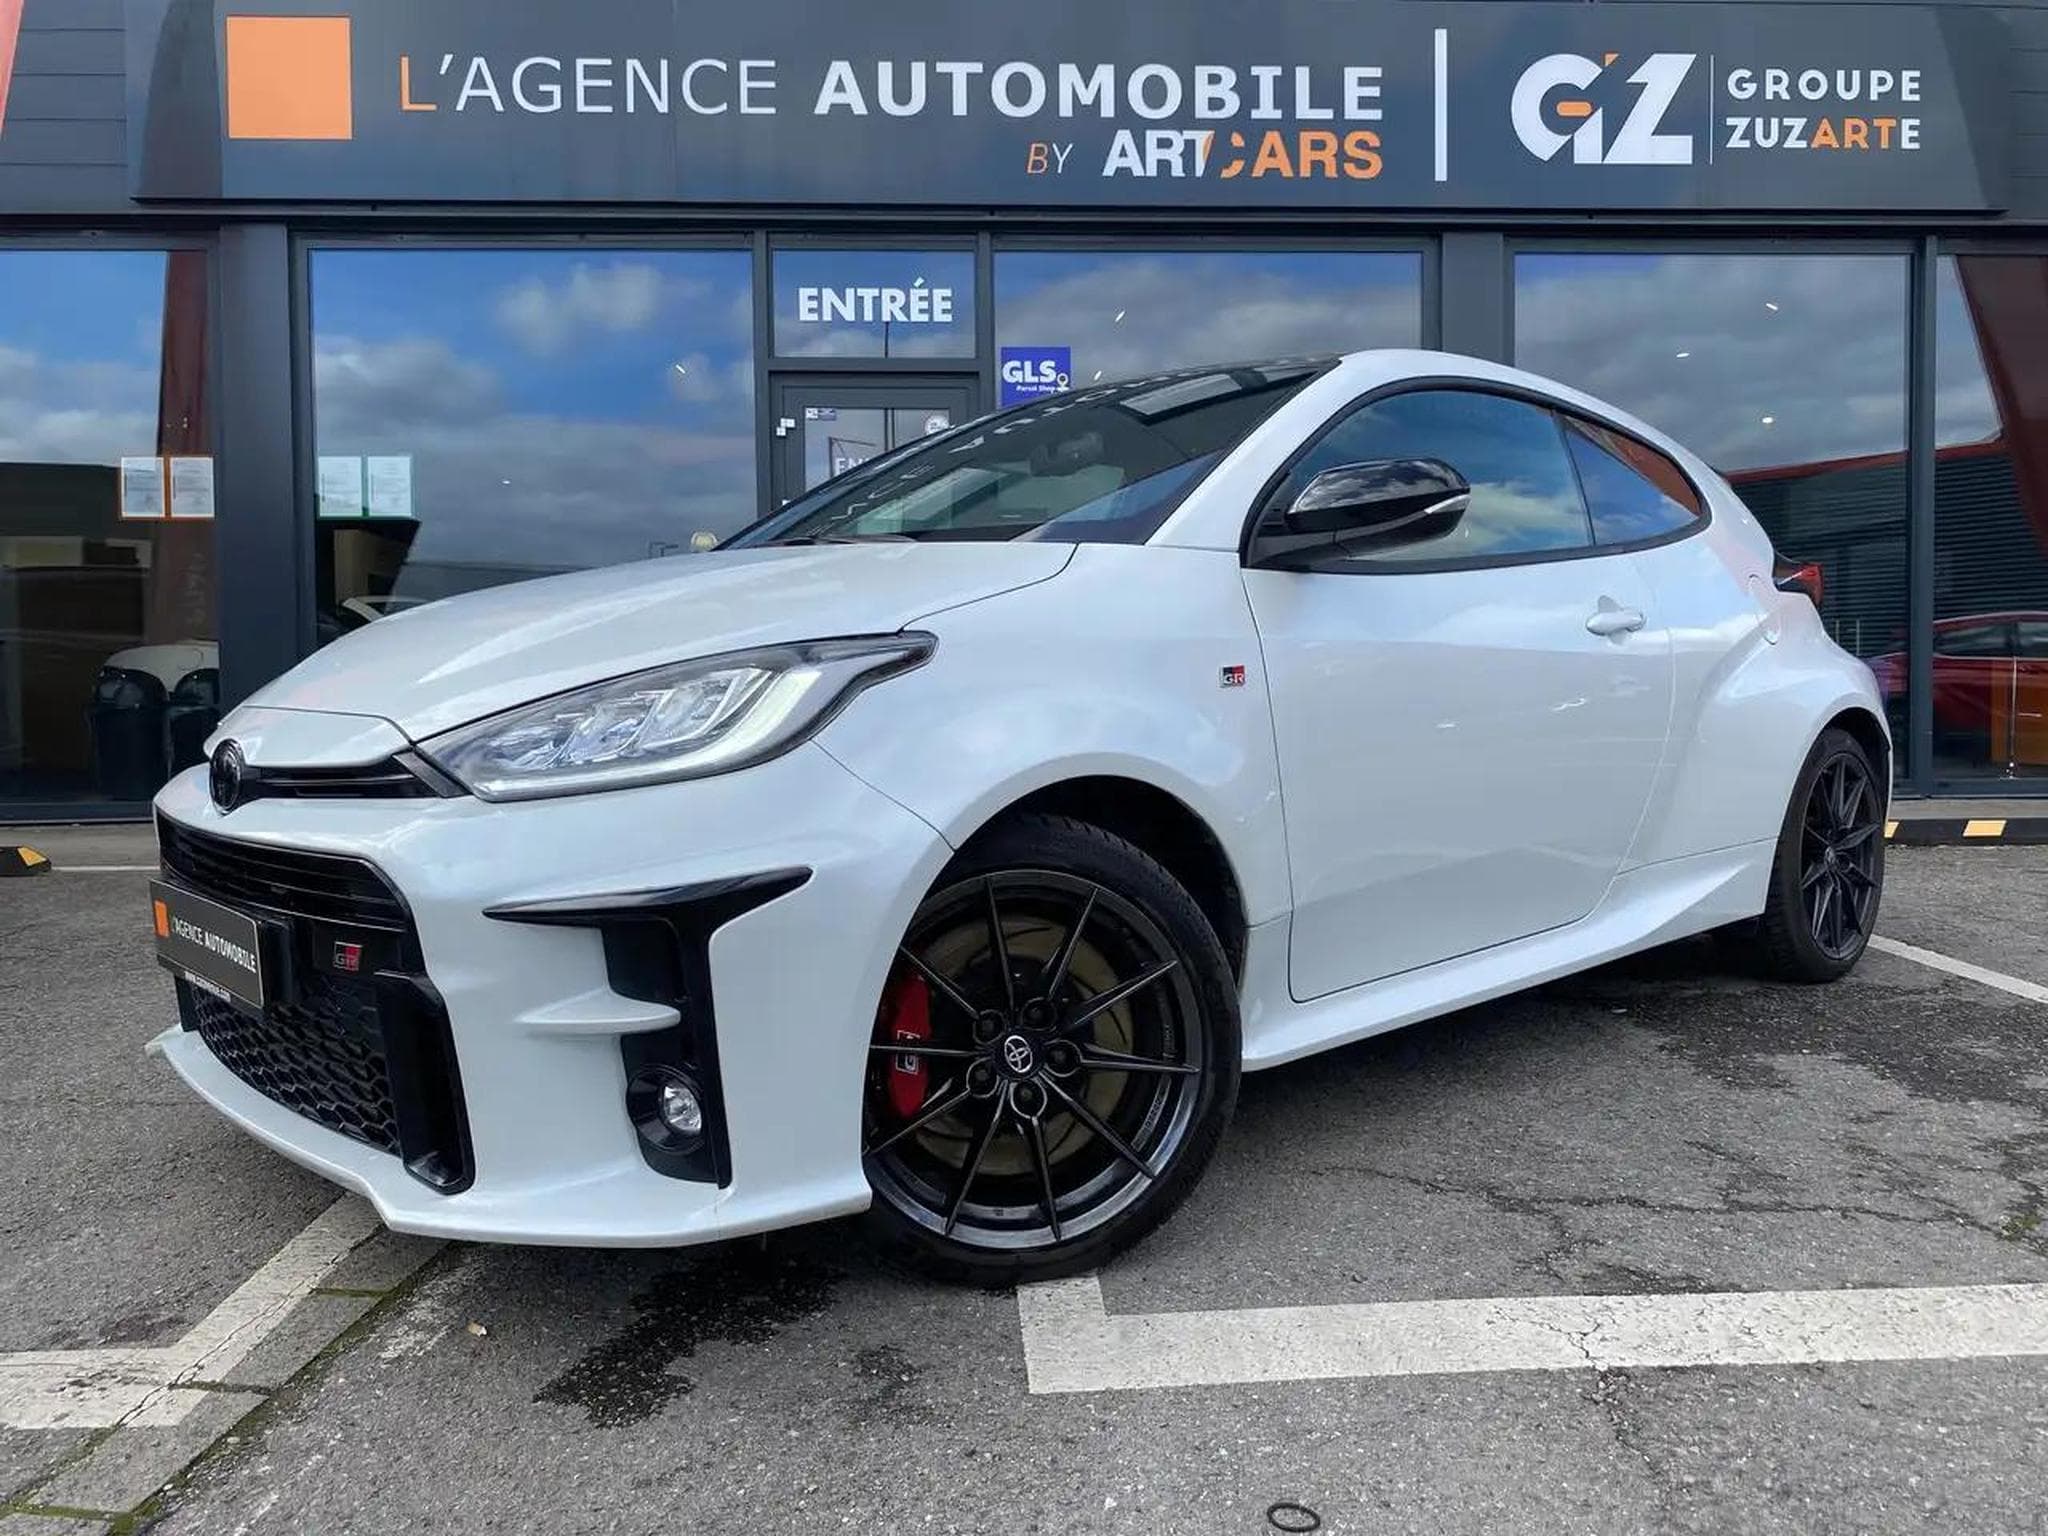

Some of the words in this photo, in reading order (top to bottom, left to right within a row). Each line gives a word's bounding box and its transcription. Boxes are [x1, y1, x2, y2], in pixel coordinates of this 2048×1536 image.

[400, 54, 776, 115] L'AGENCE
[814, 60, 1382, 120] AUTOMOBILE
[1726, 69, 1921, 101] GROUPE
[1726, 117, 1921, 150] ZUZARTE
[1027, 143, 1073, 174] BY
[798, 277, 953, 323] ENTRÉE
[1223, 673, 1244, 685] GR
[204, 931, 256, 974] AUTOMOBILE
